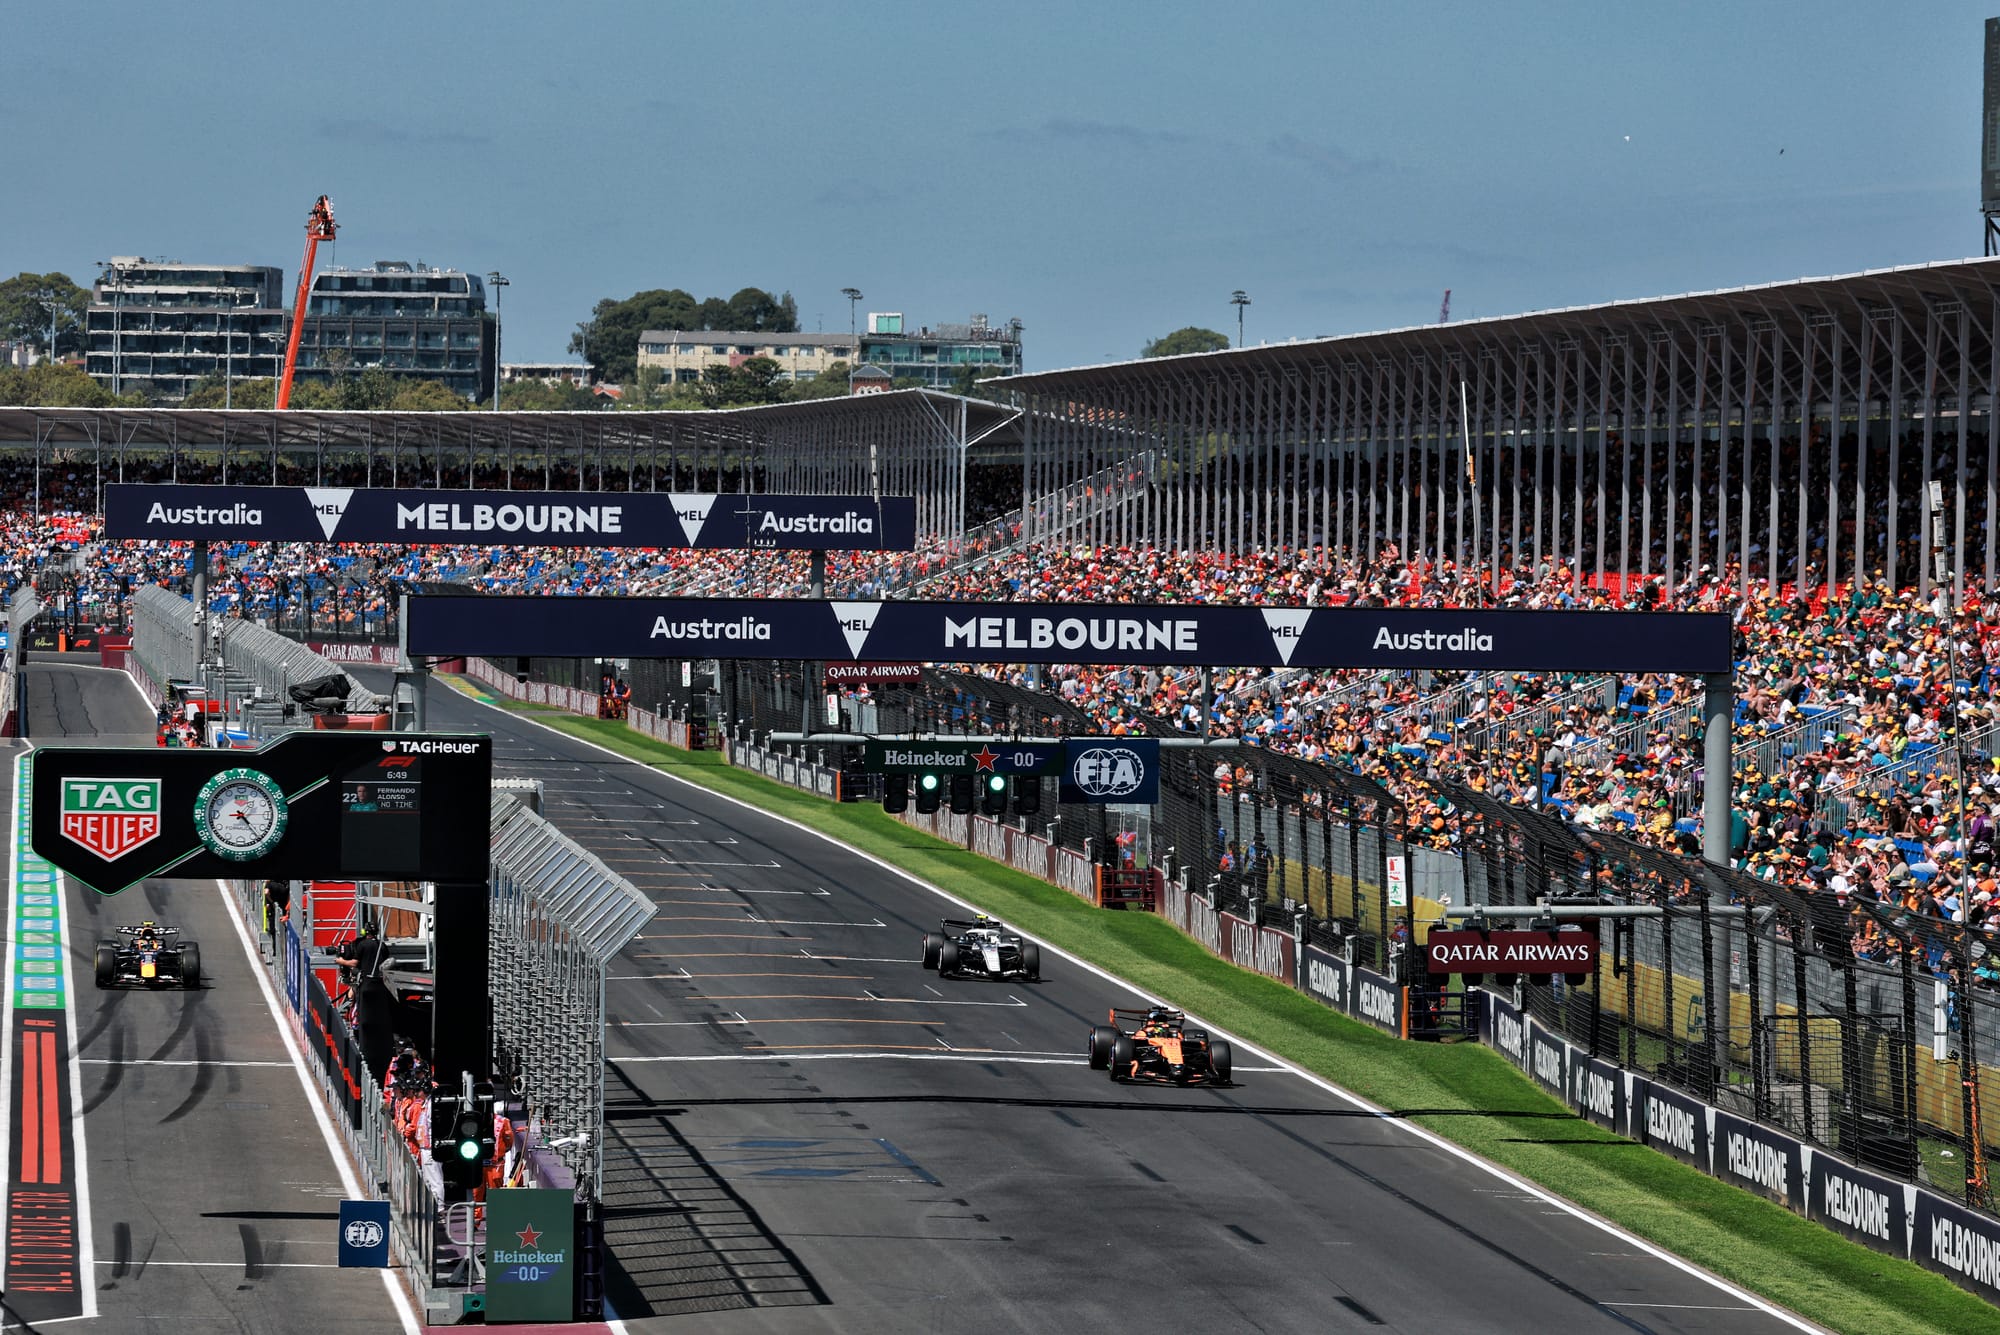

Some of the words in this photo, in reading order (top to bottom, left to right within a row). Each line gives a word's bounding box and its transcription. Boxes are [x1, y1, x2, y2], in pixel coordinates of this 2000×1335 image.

[147, 503, 262, 525] Australia
[314, 504, 343, 515] MEL
[397, 503, 622, 533] MELBOURNE
[677, 510, 707, 521] MEL
[760, 511, 873, 533] Australia
[650, 616, 771, 639] Australia
[840, 619, 870, 631] MEL
[944, 617, 1198, 650] MELBOURNE
[1270, 626, 1301, 637] MEL
[1373, 627, 1493, 651] Australia
[828, 667, 868, 679] QATAR
[870, 665, 920, 677] AIRWAYS
[884, 750, 966, 766] Heineken
[386, 771, 408, 779] 6:49
[70, 784, 151, 809] TAG
[342, 793, 358, 803] 22
[67, 816, 154, 854] HEUER
[1232, 921, 1254, 970] QATAR
[1255, 927, 1283, 977] AIRWAYS
[1432, 944, 1500, 964] QATAR
[1504, 944, 1589, 961] AIRWAYS
[1360, 980, 1396, 1027] MELBOURNE
[1643, 1094, 1695, 1155] MELBOURNE
[1727, 1129, 1788, 1195] MELBOURNE
[1825, 1170, 1890, 1241] MELBOURNE
[494, 1250, 563, 1263] Heineken
